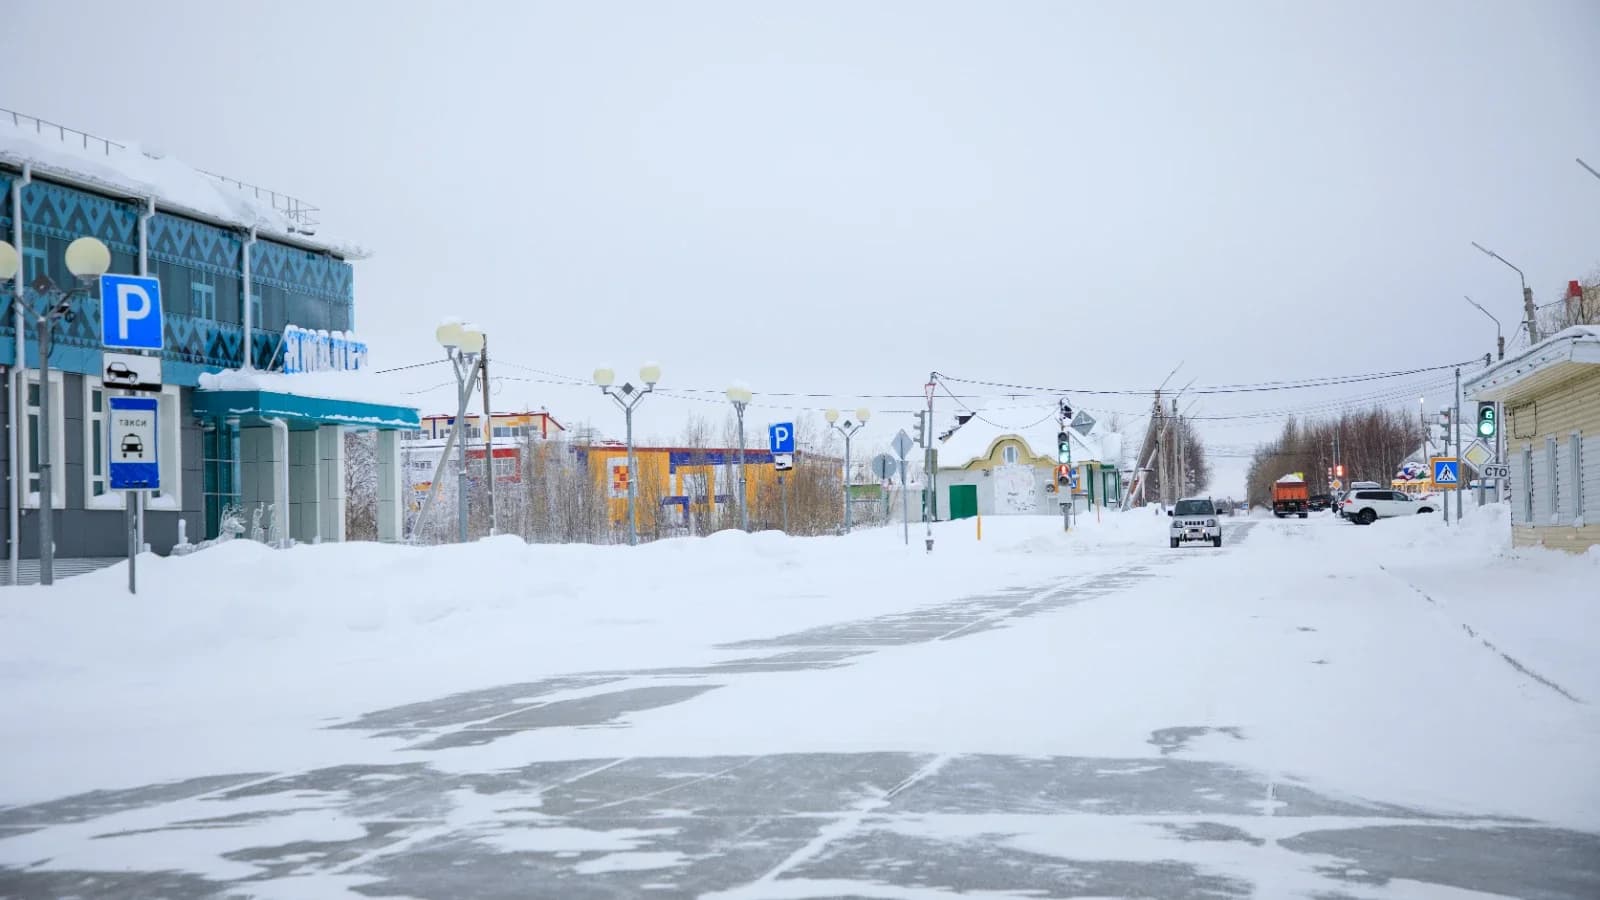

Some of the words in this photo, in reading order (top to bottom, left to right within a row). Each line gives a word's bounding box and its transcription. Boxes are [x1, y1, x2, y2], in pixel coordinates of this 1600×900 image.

[117, 283, 151, 340] P
[775, 426, 789, 449] P
[1485, 467, 1507, 477] СТО
